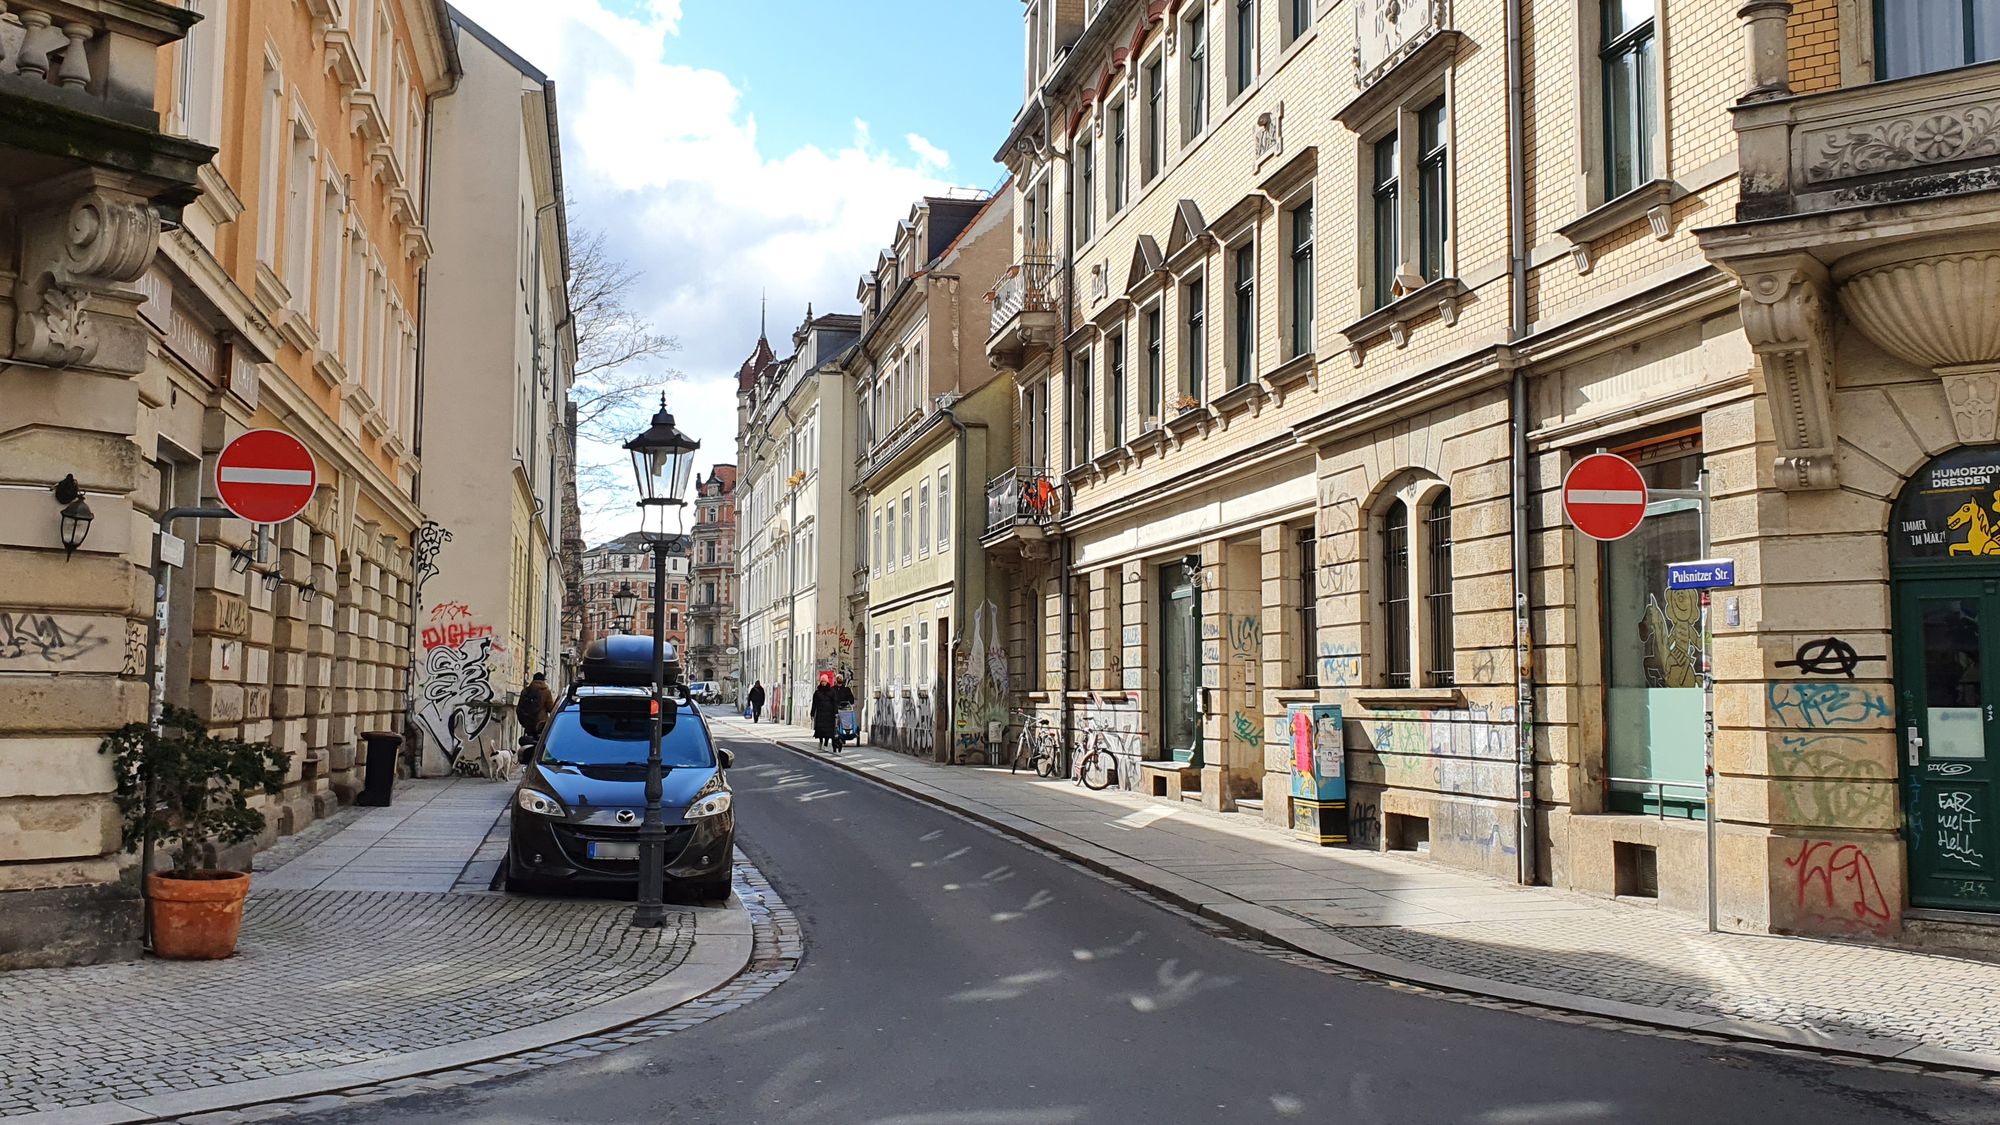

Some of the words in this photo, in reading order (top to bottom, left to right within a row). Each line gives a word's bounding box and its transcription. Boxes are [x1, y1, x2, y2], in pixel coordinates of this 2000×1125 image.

[171, 310, 216, 373] STAURANT
[1932, 475, 1991, 488] DRESDEN
[1902, 519, 1928, 532] IMMER
[1911, 535, 1923, 546] IM
[1672, 569, 1713, 583] Pulsnitzer
[1715, 567, 1730, 581] Str.
